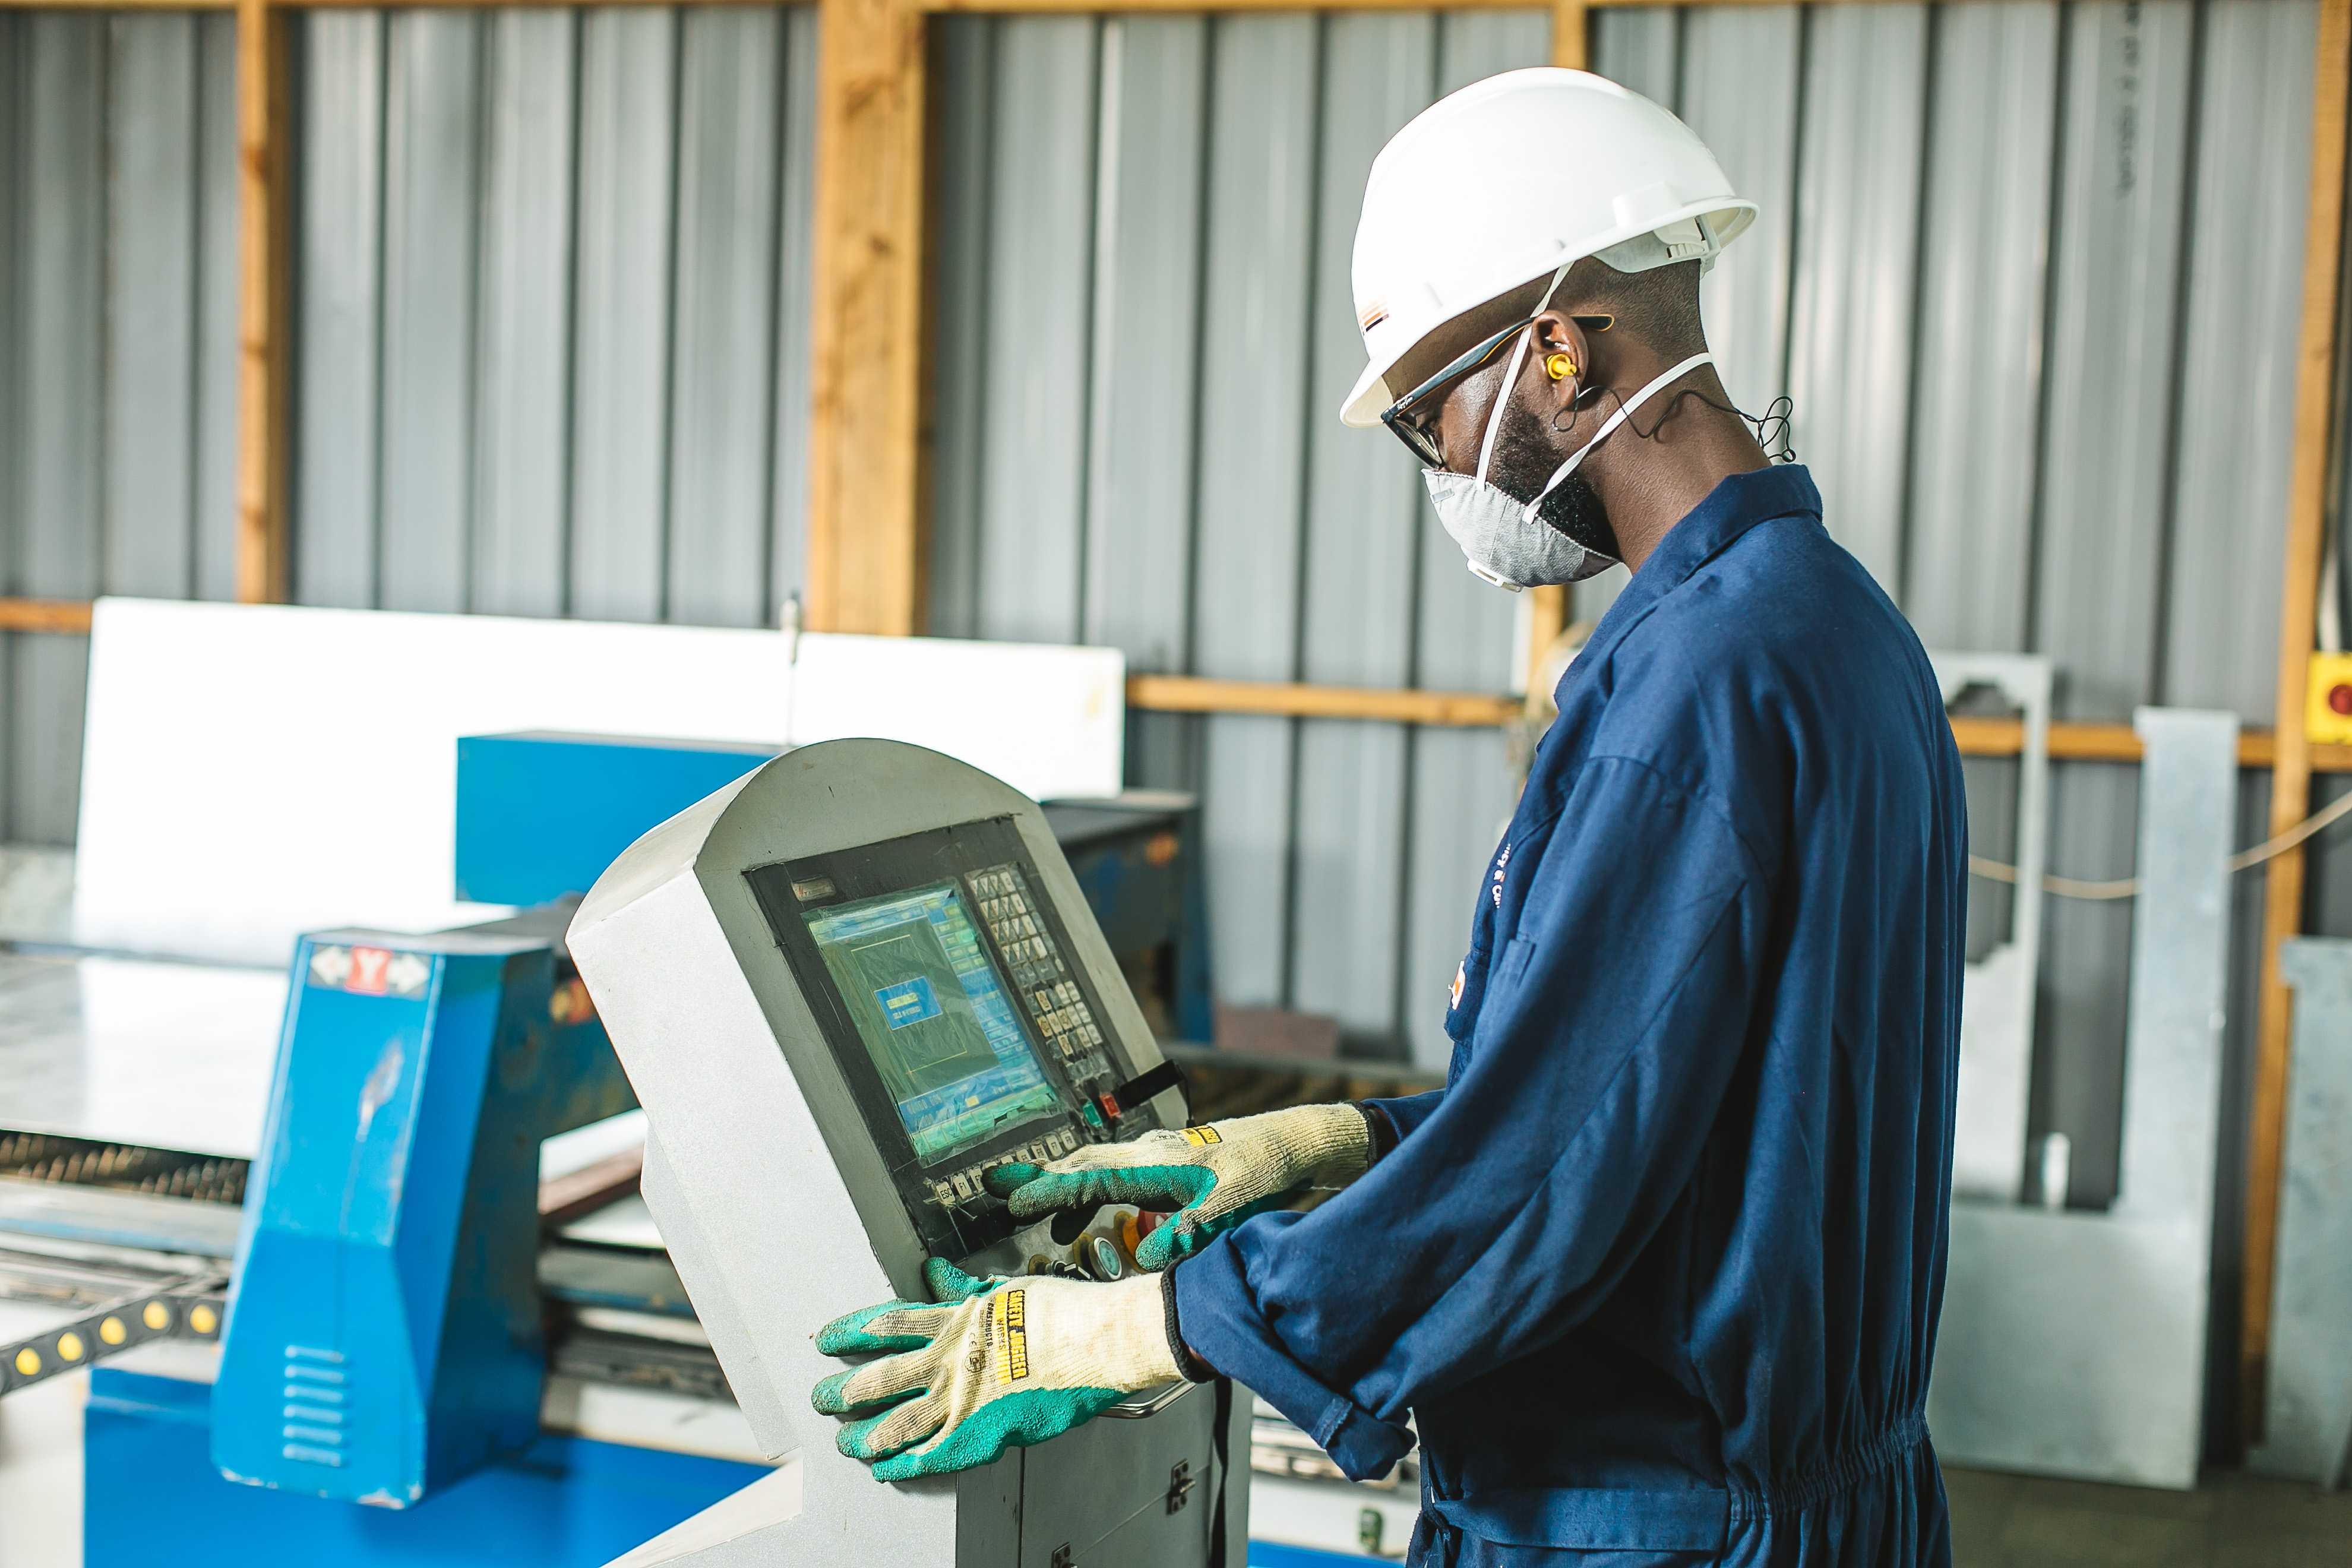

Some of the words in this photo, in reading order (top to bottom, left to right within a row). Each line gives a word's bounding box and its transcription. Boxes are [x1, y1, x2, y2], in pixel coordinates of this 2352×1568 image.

[358, 949, 387, 987] Y
[1051, 1142, 1058, 1150] F7
[940, 1187, 953, 1199] ESC
[959, 1181, 967, 1191] F1
[1009, 1290, 1023, 1327] SAFETY
[997, 1317, 1007, 1350] WORKS
[1009, 1329, 1028, 1379] JOGGER
